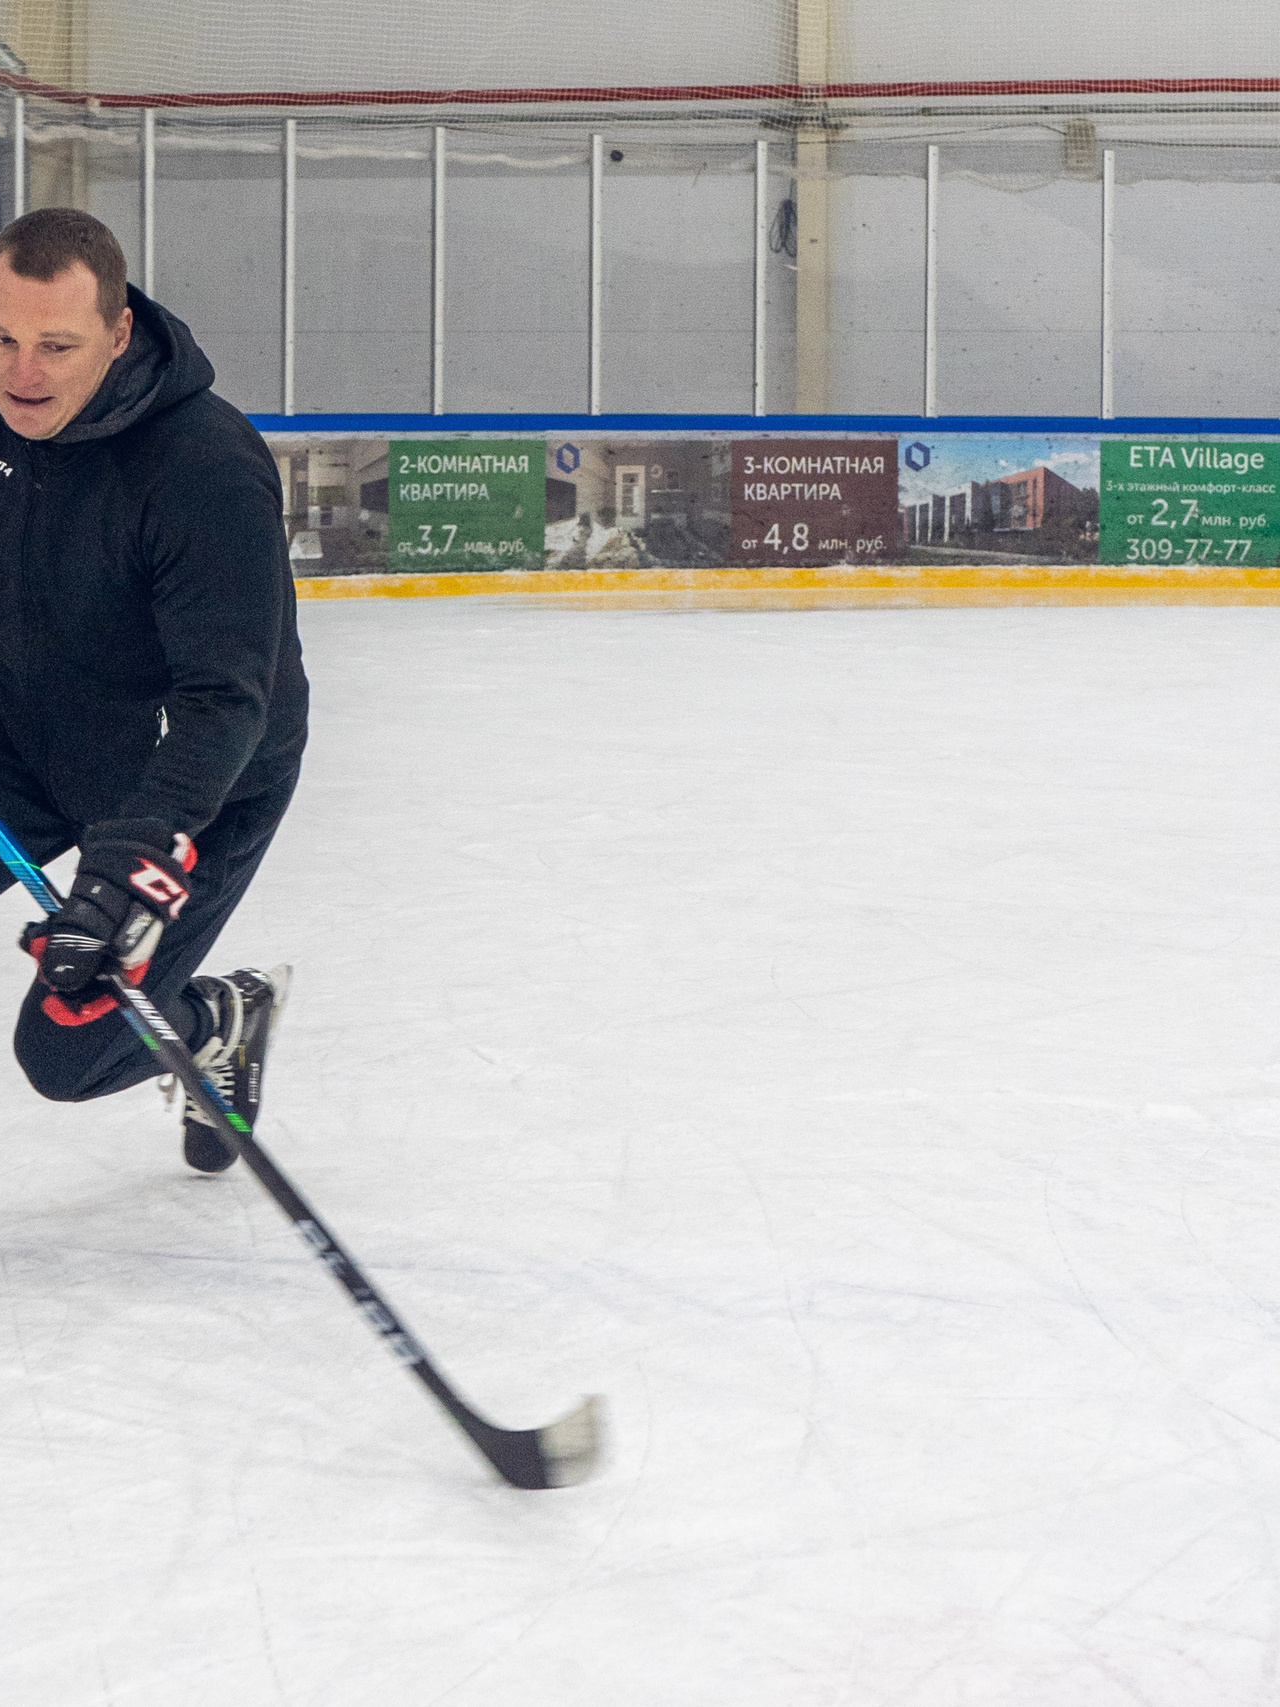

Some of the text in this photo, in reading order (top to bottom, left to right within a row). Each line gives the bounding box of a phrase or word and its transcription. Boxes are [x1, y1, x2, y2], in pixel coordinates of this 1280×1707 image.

[398, 454, 530, 475] 2-КОМНАТНАЯ
[743, 455, 885, 475] 3-КОМНАТНАЯ
[1129, 445, 1265, 475] ETA Village
[398, 482, 491, 501] КВАРТИРА
[743, 482, 843, 501] КВАРТИРА
[1126, 513, 1145, 526] от
[1150, 498, 1199, 530] 2,7
[416, 523, 458, 557] 3,7
[740, 521, 888, 555] от 4,8 млн. руб.
[1125, 537, 1253, 562] 309-77-77
